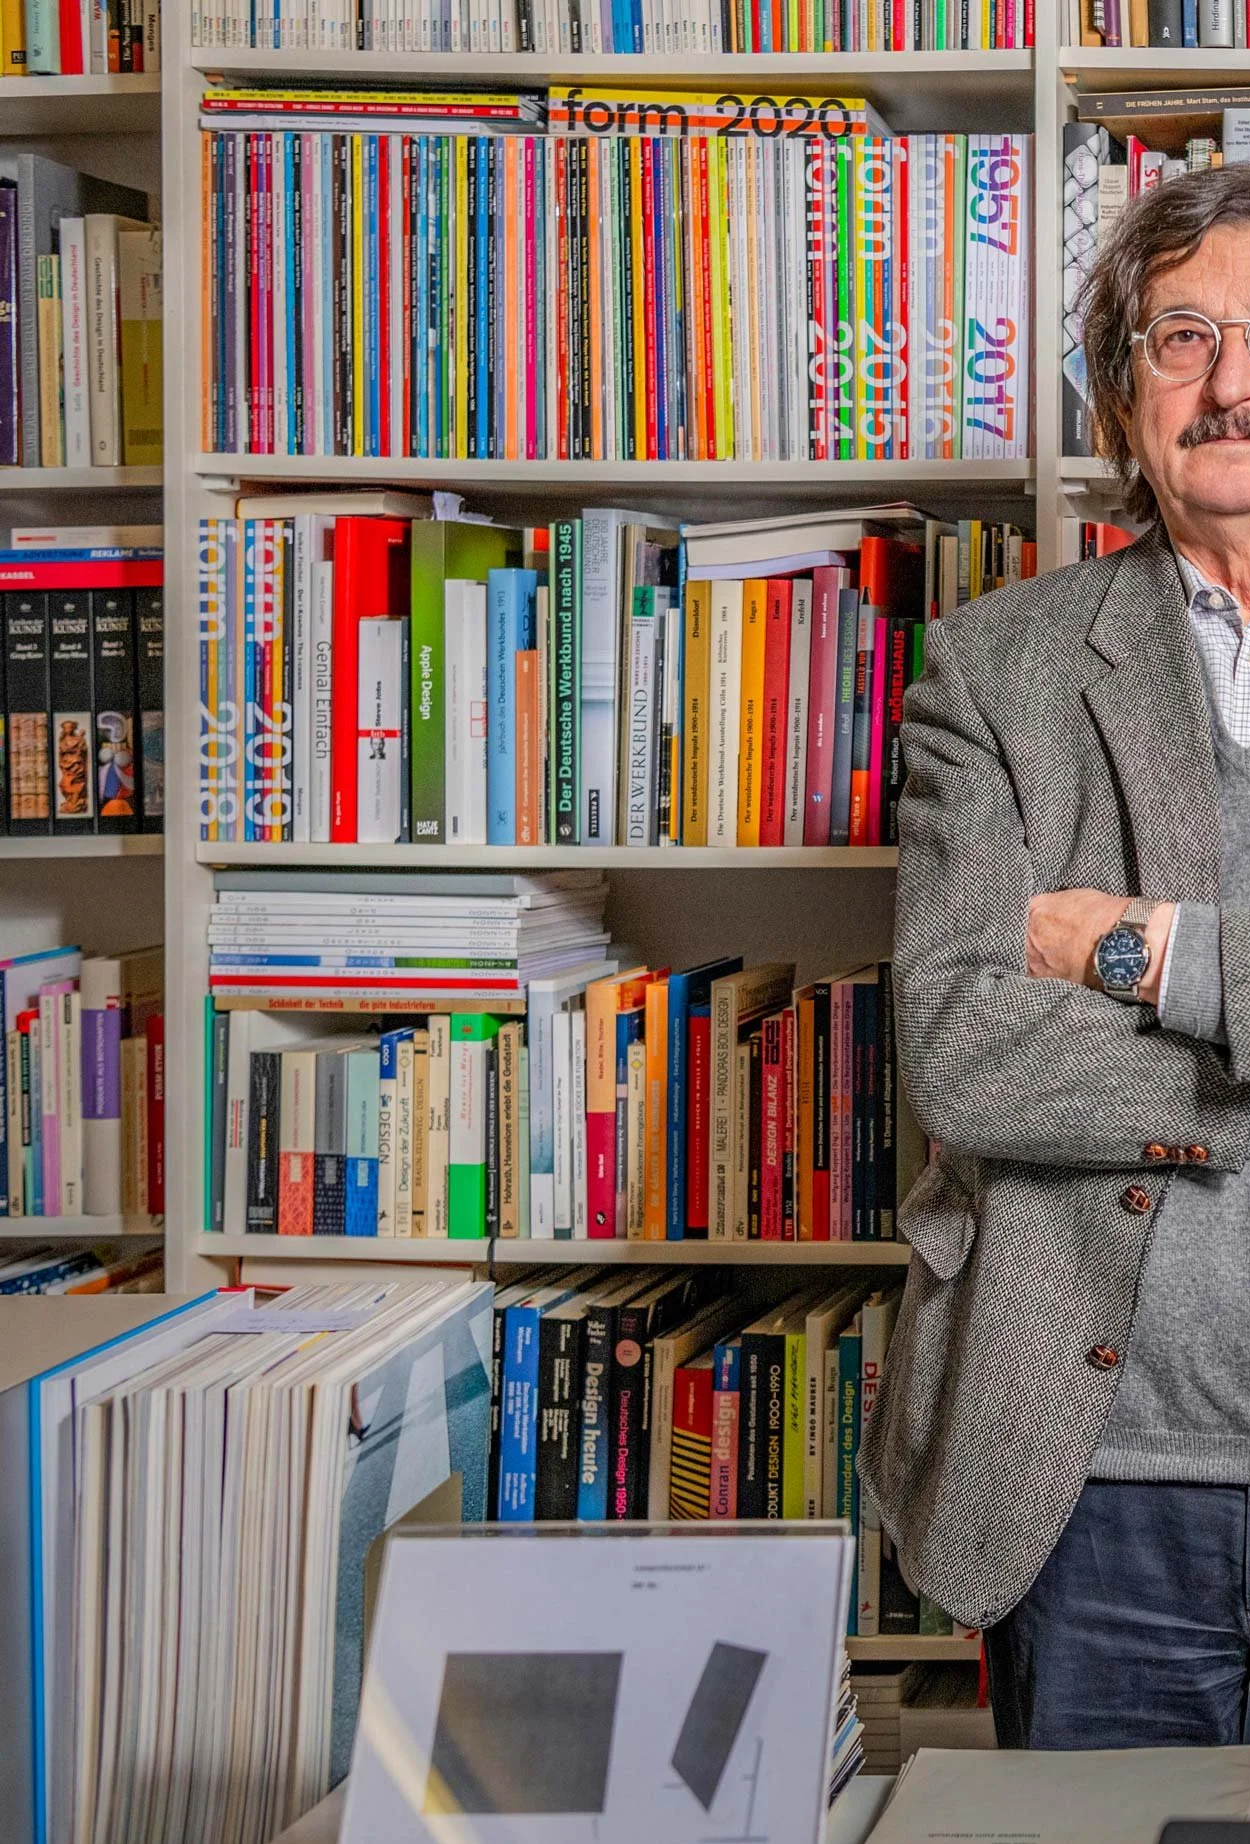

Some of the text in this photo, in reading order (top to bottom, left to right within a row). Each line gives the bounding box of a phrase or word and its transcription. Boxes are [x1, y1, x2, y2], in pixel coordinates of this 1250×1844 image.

[562, 88, 688, 135] form
[716, 96, 854, 137] 2020
[806, 140, 854, 442] form 2014
[857, 140, 907, 443] form 2015
[967, 136, 1020, 442] 1957 2017
[914, 320, 958, 442] 2016
[200, 520, 239, 825] form 2018
[246, 520, 292, 826] form 2019
[315, 641, 332, 759] Genial Einfach
[419, 645, 433, 719] Apple Design
[559, 525, 572, 812] Der Deutsche Werkbund nach 1945
[889, 630, 905, 784] Robert Kisch MÖBELHAUS
[630, 690, 648, 839] DER WERKBUND
[382, 1044, 390, 1065] LOCO
[379, 1111, 391, 1164] DESIGN
[766, 1075, 778, 1165] DESIGN BILANZ
[581, 1362, 604, 1484] Design heute
[615, 1390, 631, 1484] Deutsches Design
[713, 1395, 736, 1515] Conran design
[810, 1445, 816, 1456] BY
